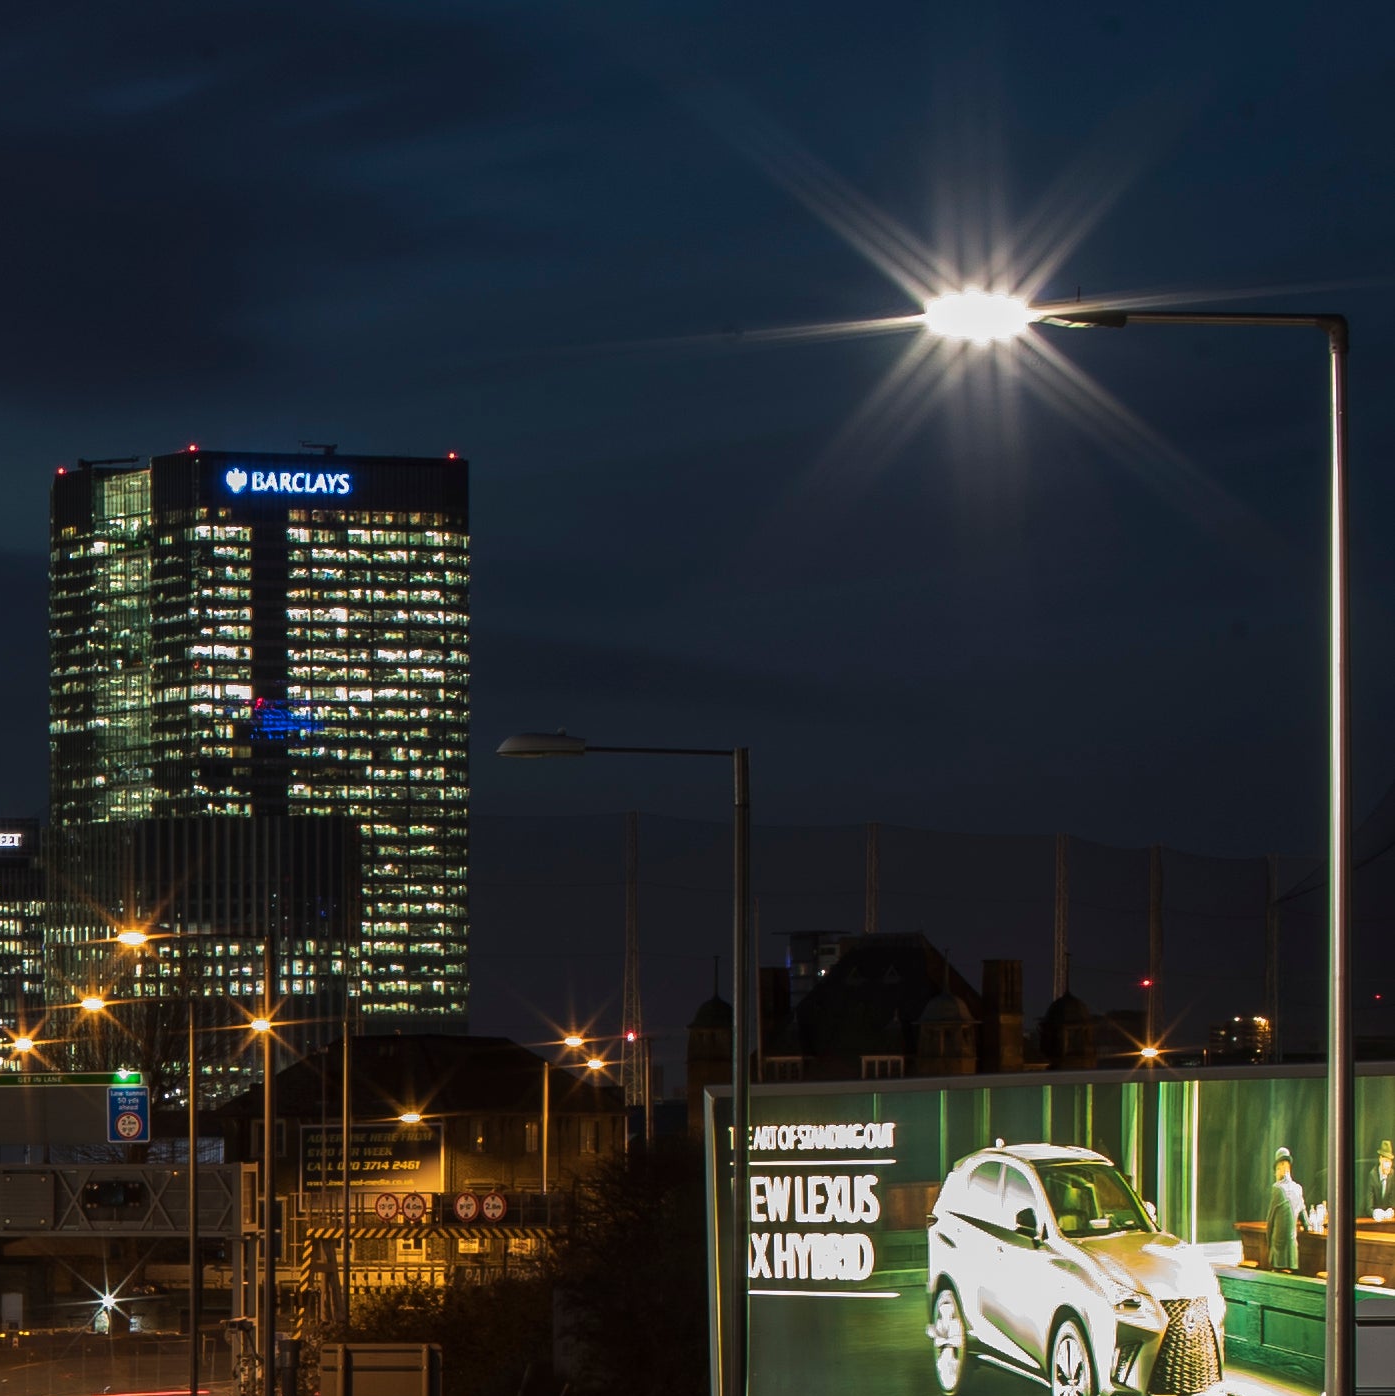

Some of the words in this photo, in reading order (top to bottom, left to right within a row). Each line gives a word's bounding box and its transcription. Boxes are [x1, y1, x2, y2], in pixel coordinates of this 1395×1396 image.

[251, 472, 350, 495] BARCLAYS
[362, 1161, 389, 1171] 3714
[794, 1174, 881, 1224] LEXUS
